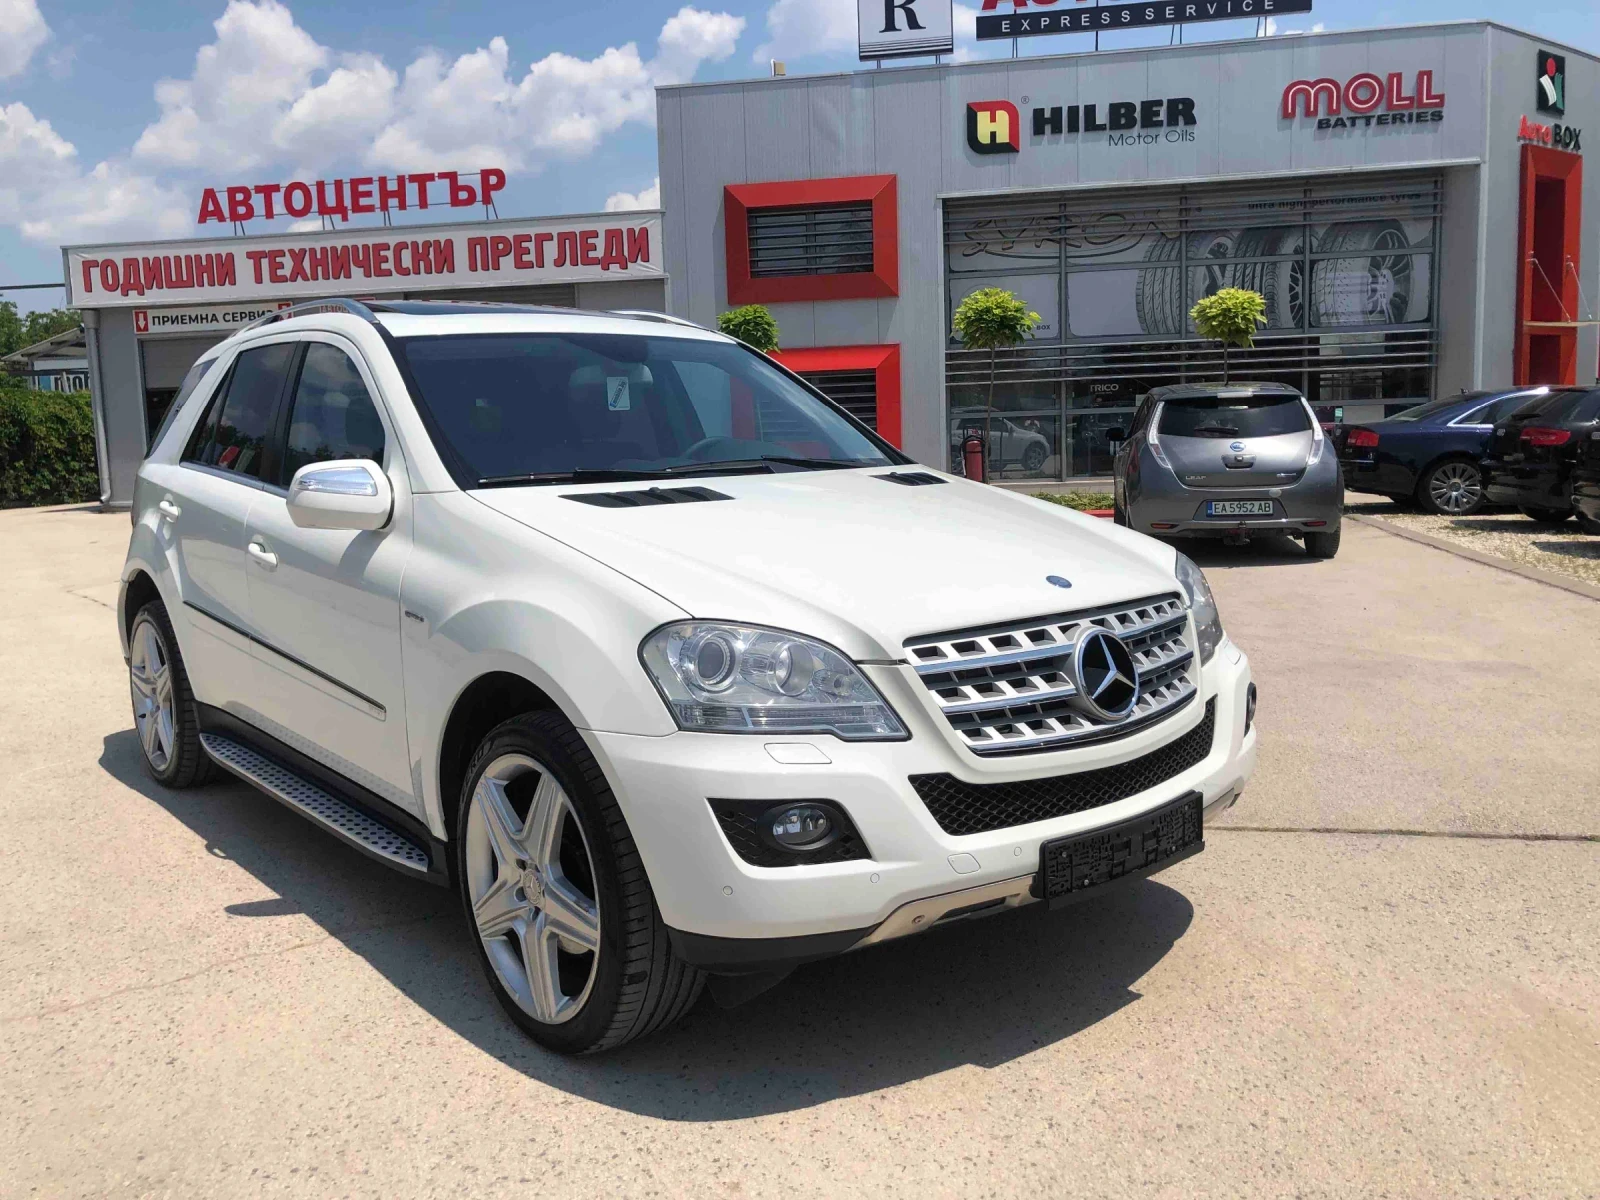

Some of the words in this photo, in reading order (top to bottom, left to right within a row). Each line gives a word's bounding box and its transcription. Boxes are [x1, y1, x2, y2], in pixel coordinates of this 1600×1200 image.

[1001, 11, 1131, 33] EXPRESS
[1145, 0, 1275, 20] SERVICE
[1032, 97, 1197, 136] HILBER
[1317, 109, 1444, 130] BATTERIES
[1108, 132, 1161, 147] Motor
[1165, 129, 1196, 144] Oils
[197, 168, 506, 224] АВТОЦЕНТЪР
[81, 252, 237, 297] ГОДИШНИ
[246, 238, 455, 285] ТЕХНИЧЕСКИ
[467, 226, 650, 273] ПРЕГЛЕДИ
[151, 311, 219, 326] ПРИЕМНА
[1090, 383, 1119, 392] TRICO
[1214, 504, 1227, 513] EA
[1229, 503, 1254, 513] 5952
[1257, 503, 1271, 512] AB
